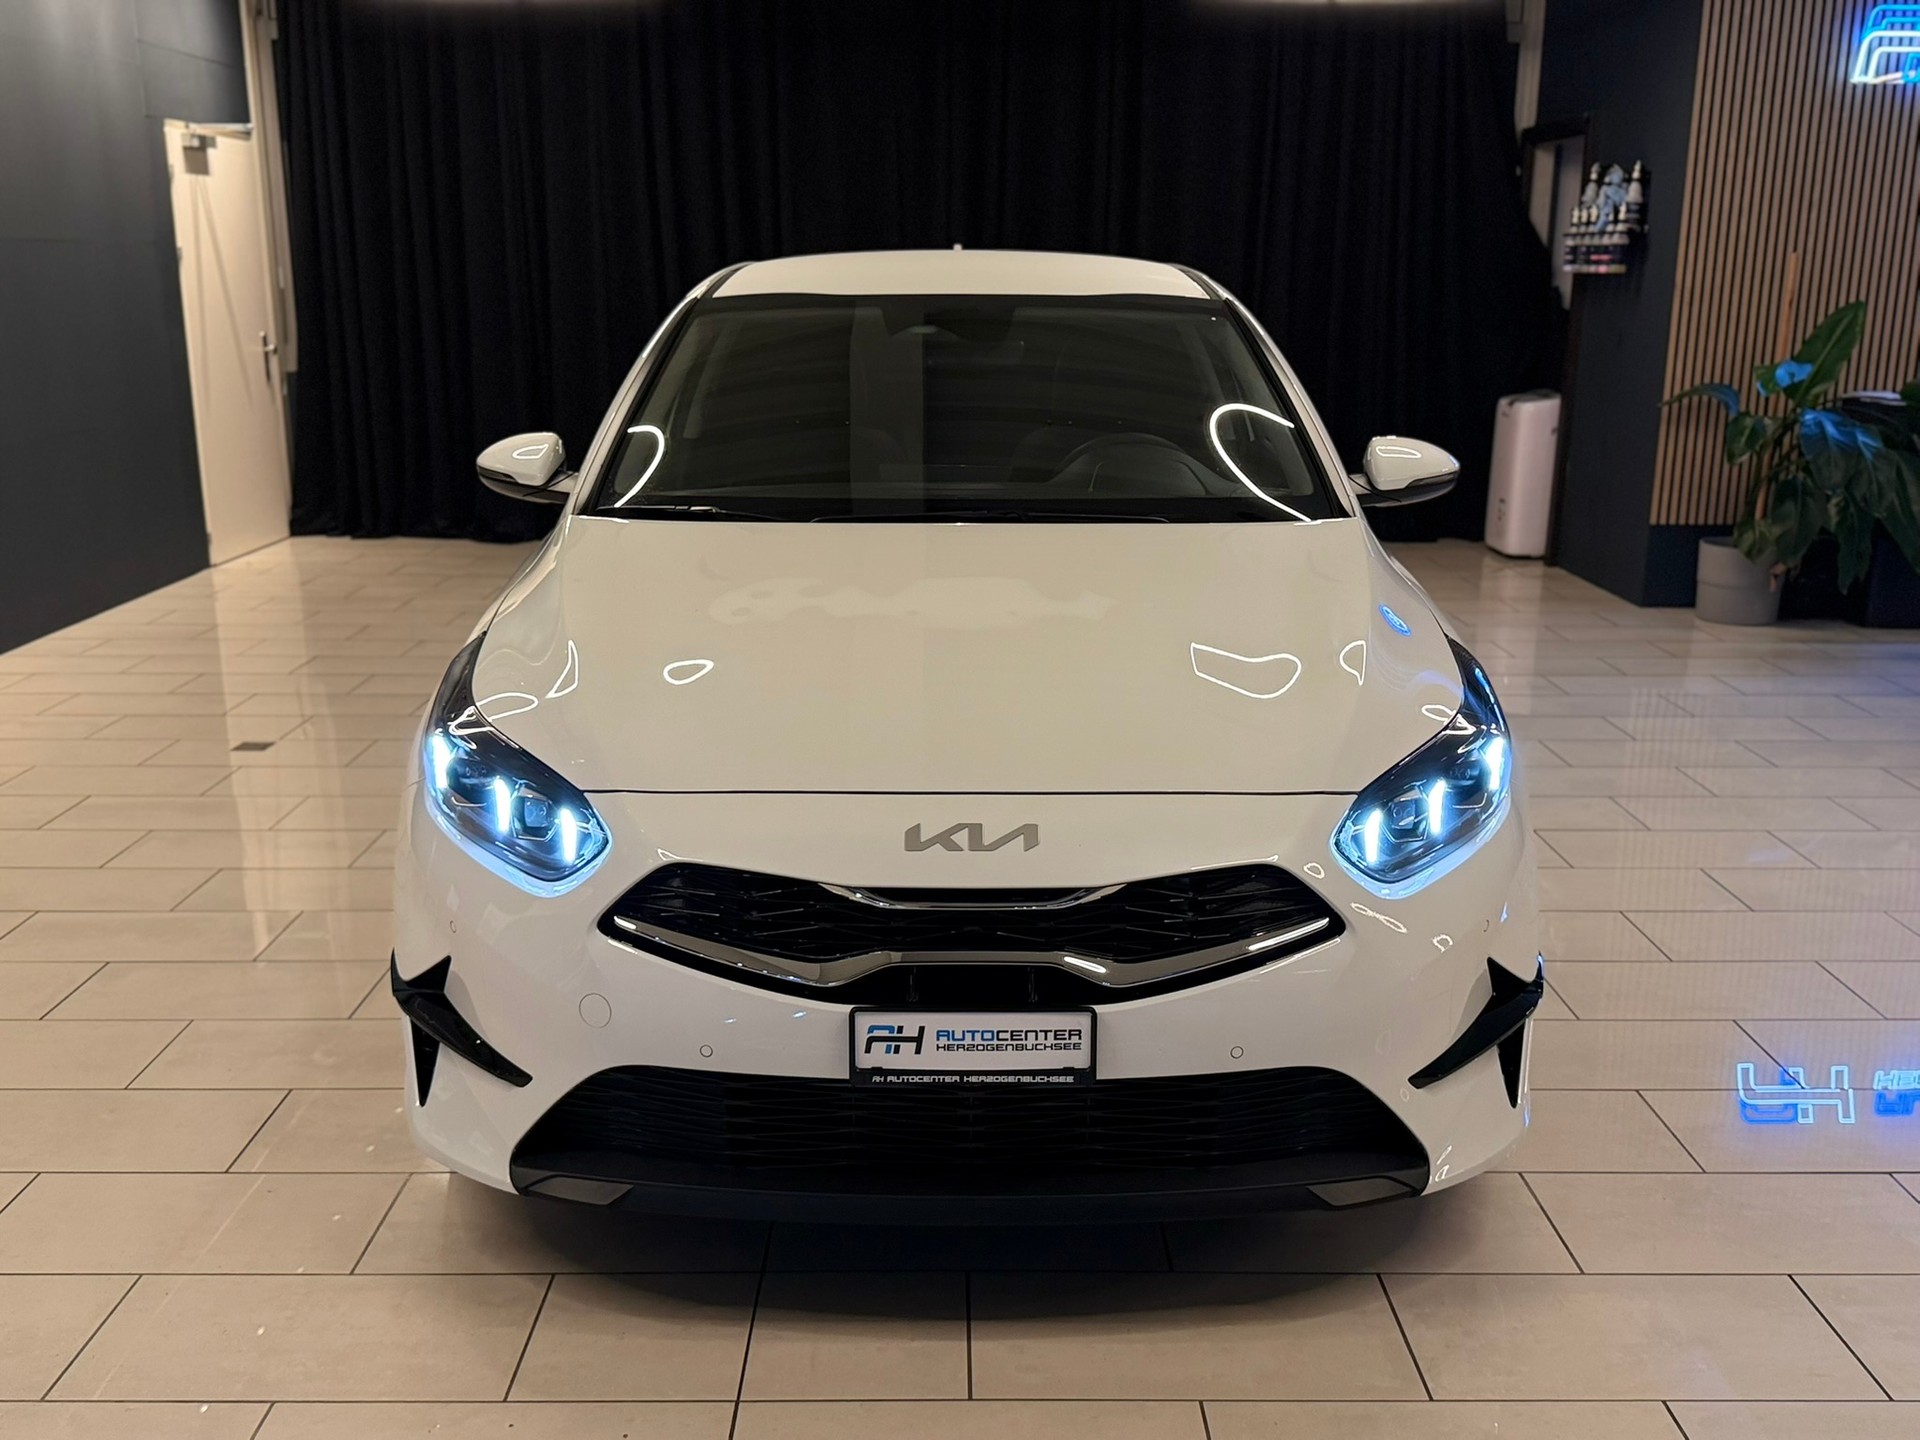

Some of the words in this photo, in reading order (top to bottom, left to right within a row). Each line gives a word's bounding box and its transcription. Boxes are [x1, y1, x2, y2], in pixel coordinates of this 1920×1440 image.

[904, 822, 1040, 853] KIA
[936, 1029, 1083, 1042] AUTOCENTER
[936, 1042, 1082, 1052] HERZOGENBUCHSEE
[887, 1075, 960, 1083] AUTOCENTER
[963, 1075, 1075, 1083] HERZOGENBUCHSEE
